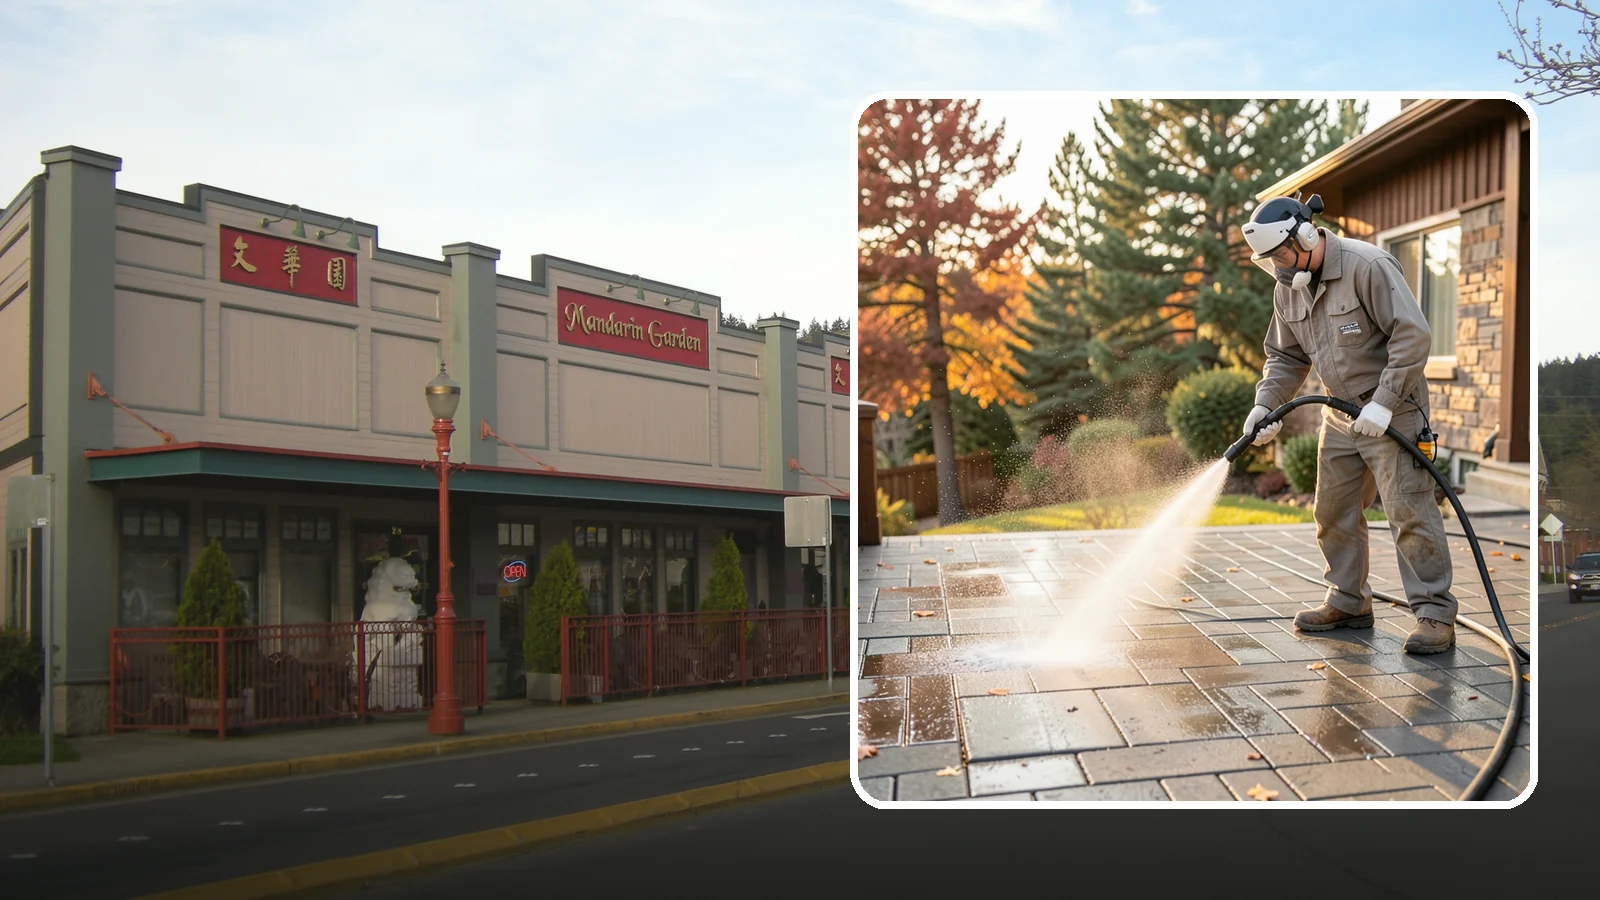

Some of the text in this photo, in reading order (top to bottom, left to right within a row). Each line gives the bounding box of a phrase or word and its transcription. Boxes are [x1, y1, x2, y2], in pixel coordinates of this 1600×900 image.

[231, 235, 346, 291] 文華園
[564, 302, 702, 352] Mandarin Garden
[503, 565, 527, 578] OPEN
